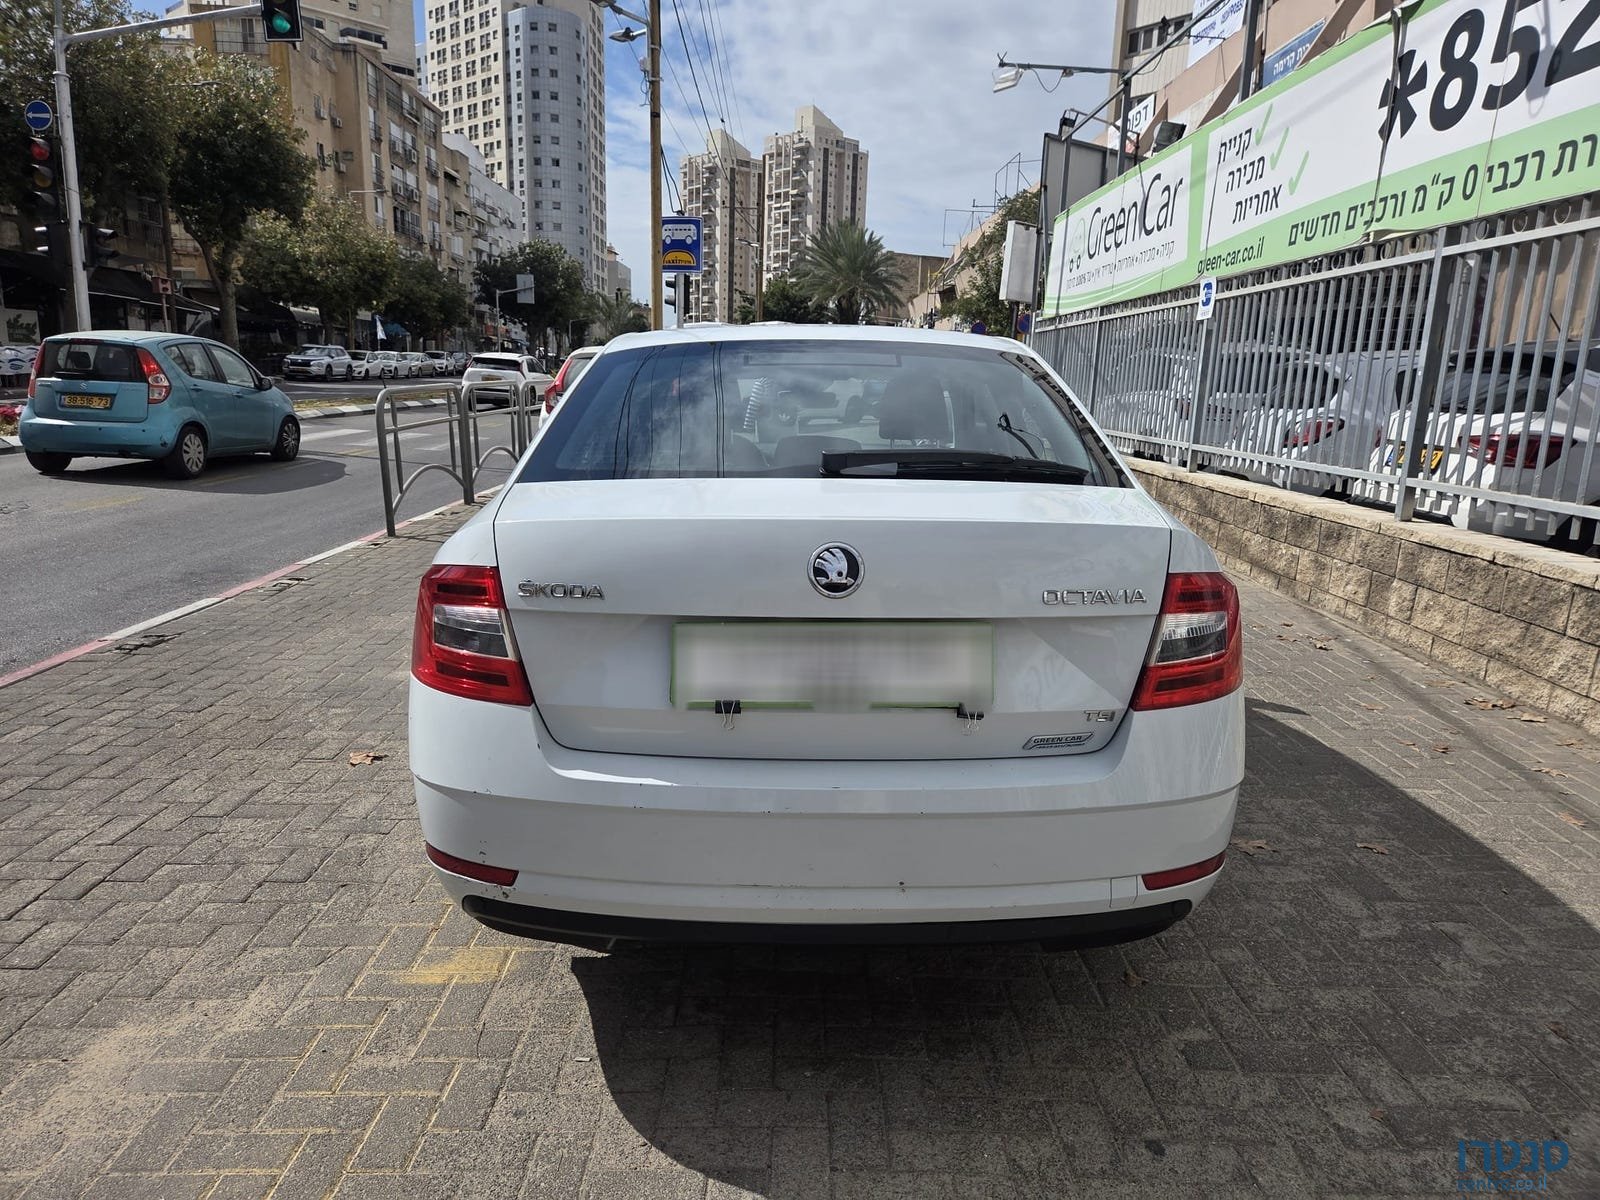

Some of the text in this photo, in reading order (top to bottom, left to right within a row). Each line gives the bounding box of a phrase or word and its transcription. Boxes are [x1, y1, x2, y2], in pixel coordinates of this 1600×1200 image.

[1226, 155, 1265, 193] מכירה
[1462, 164, 1478, 200] 0
[1486, 149, 1545, 194] רכבי
[1232, 184, 1282, 224] אחריות
[1288, 210, 1341, 246] חדשים
[1042, 588, 1147, 605] OCTAVIA
[1084, 709, 1116, 722] TSI
[1033, 736, 1063, 744] GREEN
